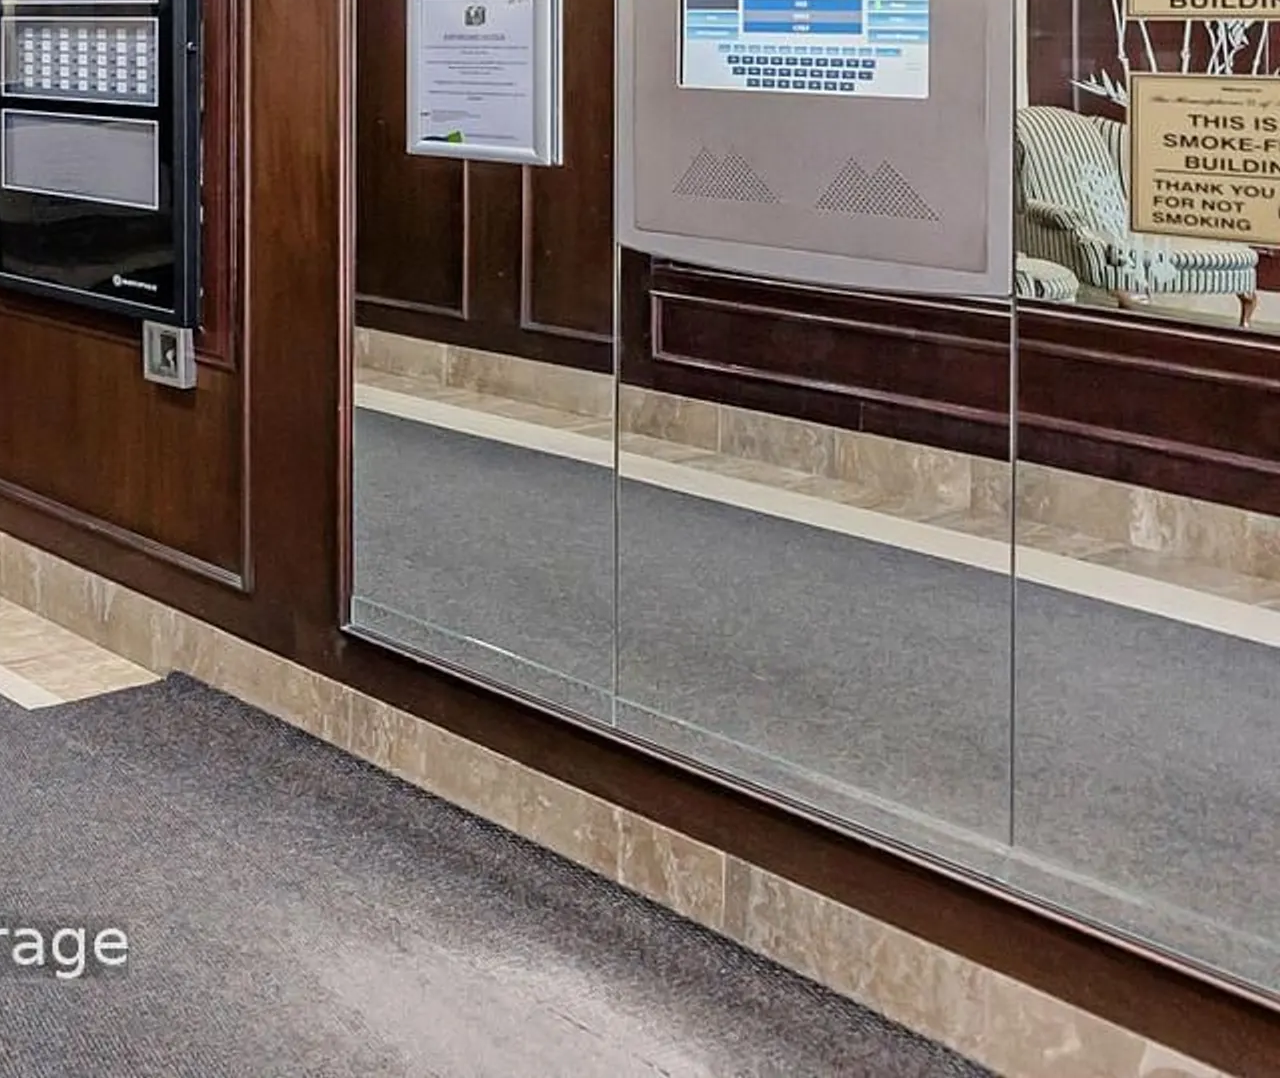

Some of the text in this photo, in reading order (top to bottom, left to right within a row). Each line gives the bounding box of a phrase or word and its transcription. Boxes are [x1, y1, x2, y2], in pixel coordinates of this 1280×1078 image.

[1187, 114, 1277, 132] THIS IS
[1162, 133, 1280, 153] SMOKE-F
[1153, 178, 1275, 199] THANK YOU
[1153, 195, 1245, 213] FOR NOT
[1152, 211, 1252, 232] SMOKING
